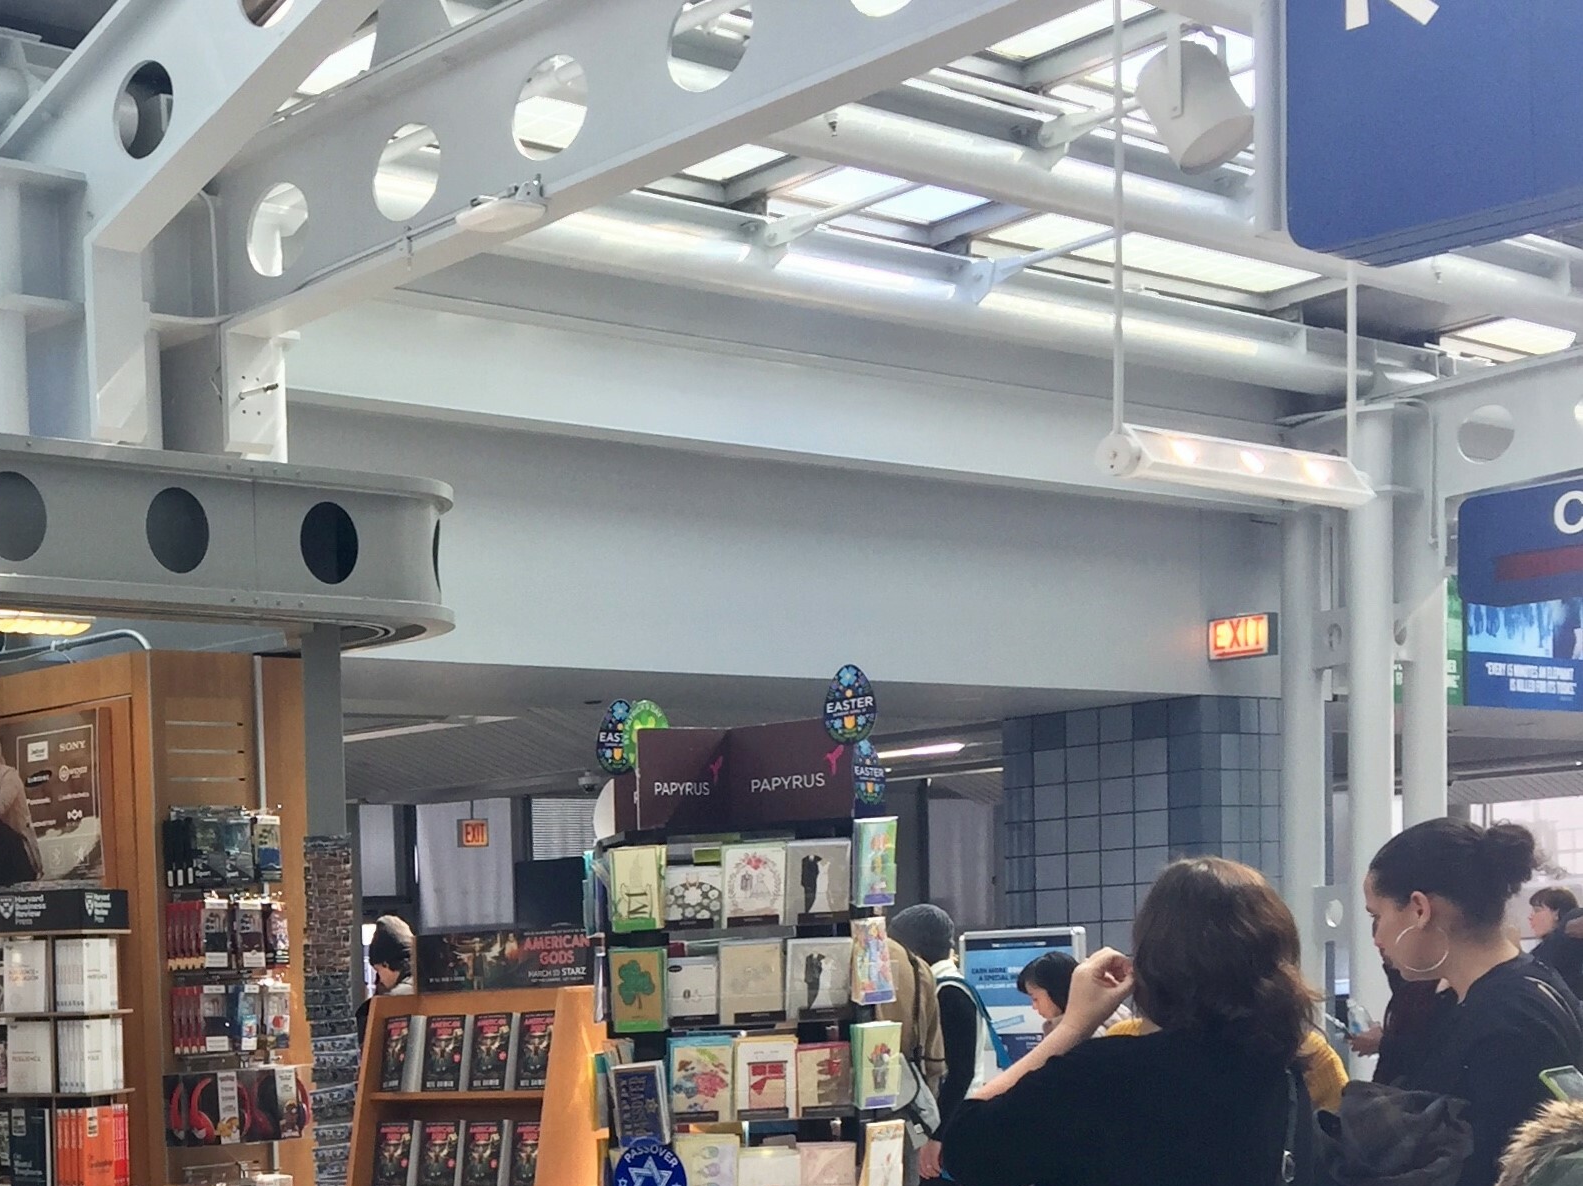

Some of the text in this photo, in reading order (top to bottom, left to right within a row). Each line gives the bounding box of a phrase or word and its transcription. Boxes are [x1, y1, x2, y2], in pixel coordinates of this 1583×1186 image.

[1213, 616, 1264, 651] EXIT
[826, 696, 874, 715] EASTER
[59, 740, 86, 752] SONY
[854, 766, 885, 779] EASTER
[654, 781, 710, 796] PAPYRUS
[751, 772, 826, 793] PAPYRUS
[465, 823, 485, 843] EXIT
[15, 894, 44, 902] Harvard
[15, 902, 46, 911] Business
[524, 934, 590, 950] AMERICAN
[539, 950, 575, 965] GODS
[561, 966, 587, 976] STARZ
[624, 1145, 678, 1168] PASSOVER
